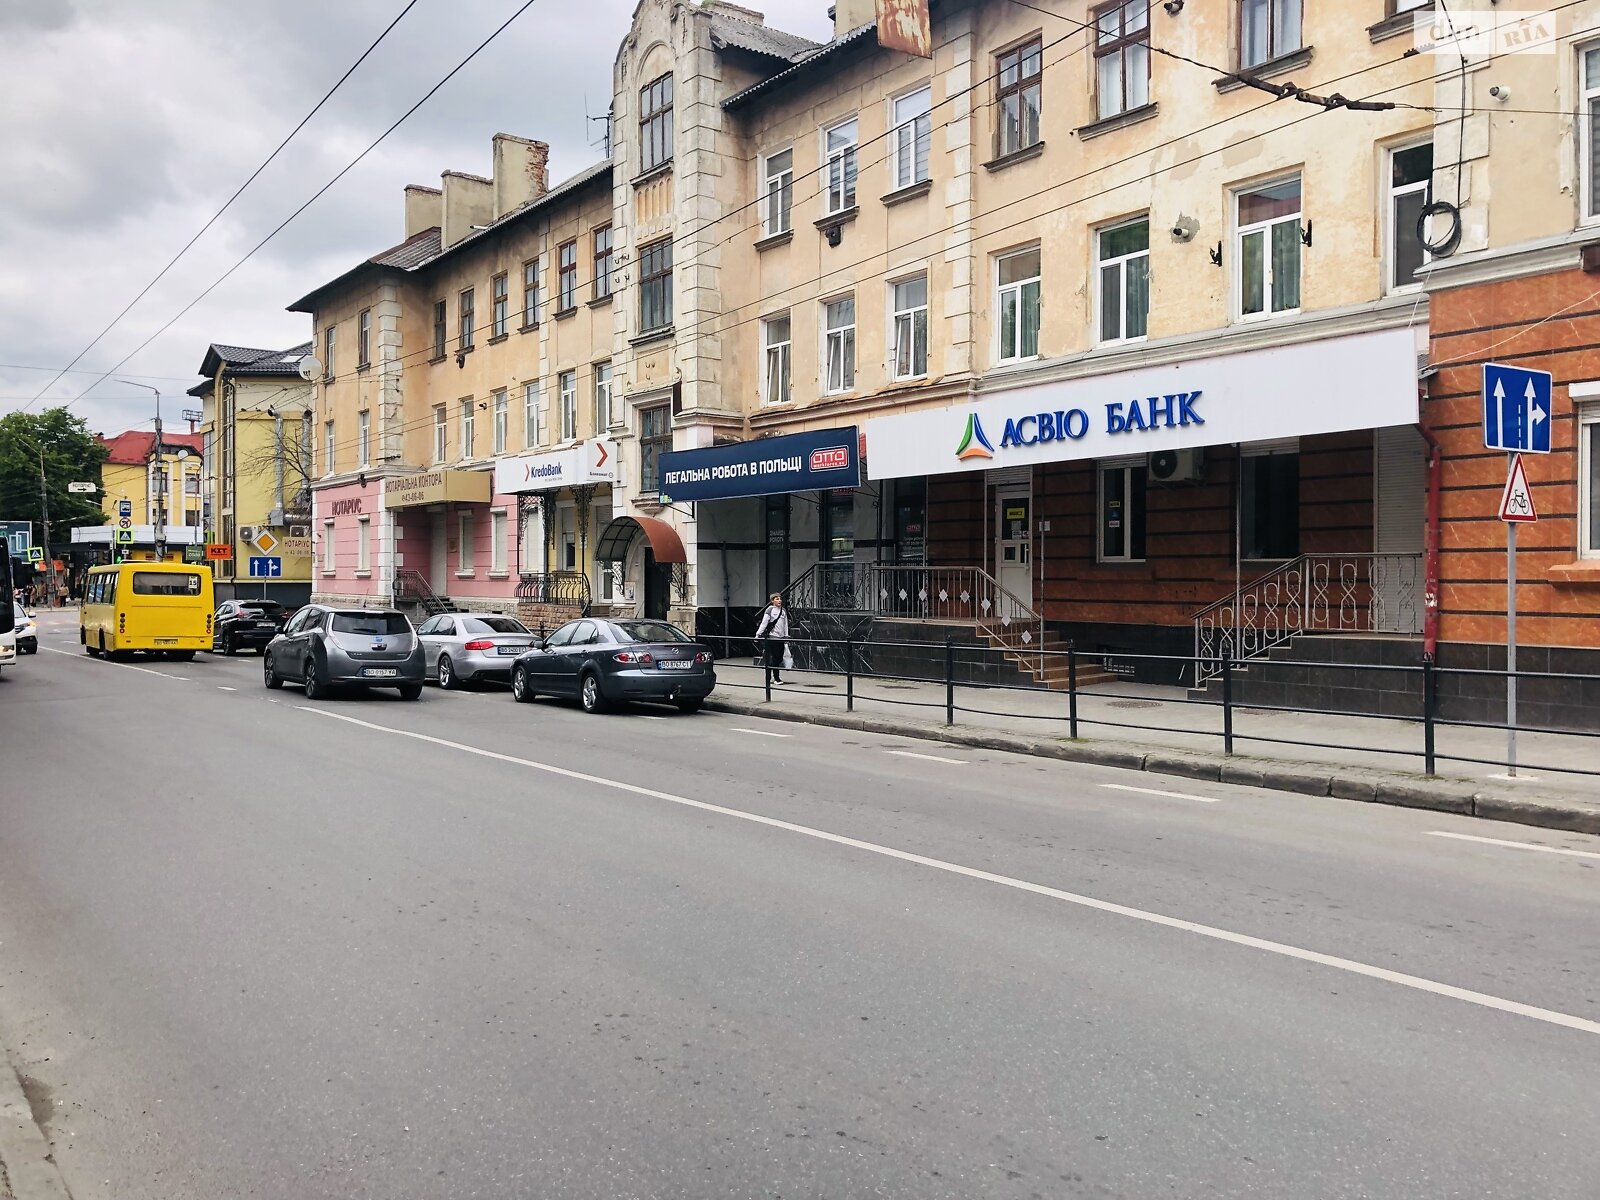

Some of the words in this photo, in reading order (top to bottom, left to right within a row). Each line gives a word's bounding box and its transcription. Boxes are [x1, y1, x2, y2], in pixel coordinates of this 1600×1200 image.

[999, 408, 1089, 448] АСВІО
[1104, 391, 1205, 434] БАНК
[812, 450, 845, 462] OTTO
[531, 462, 562, 478] KredoBank
[665, 467, 710, 485] ЛЕГАЛЬНА
[712, 461, 748, 480] РОБОТА
[750, 464, 757, 475] В
[759, 456, 801, 475] ПОЛЬЩІ
[385, 477, 417, 494] НОТАРІАЛЬНА
[418, 473, 442, 489] КОНТОРА
[331, 499, 362, 516] НОТАРІУС
[284, 540, 310, 548] НОТАРІУС
